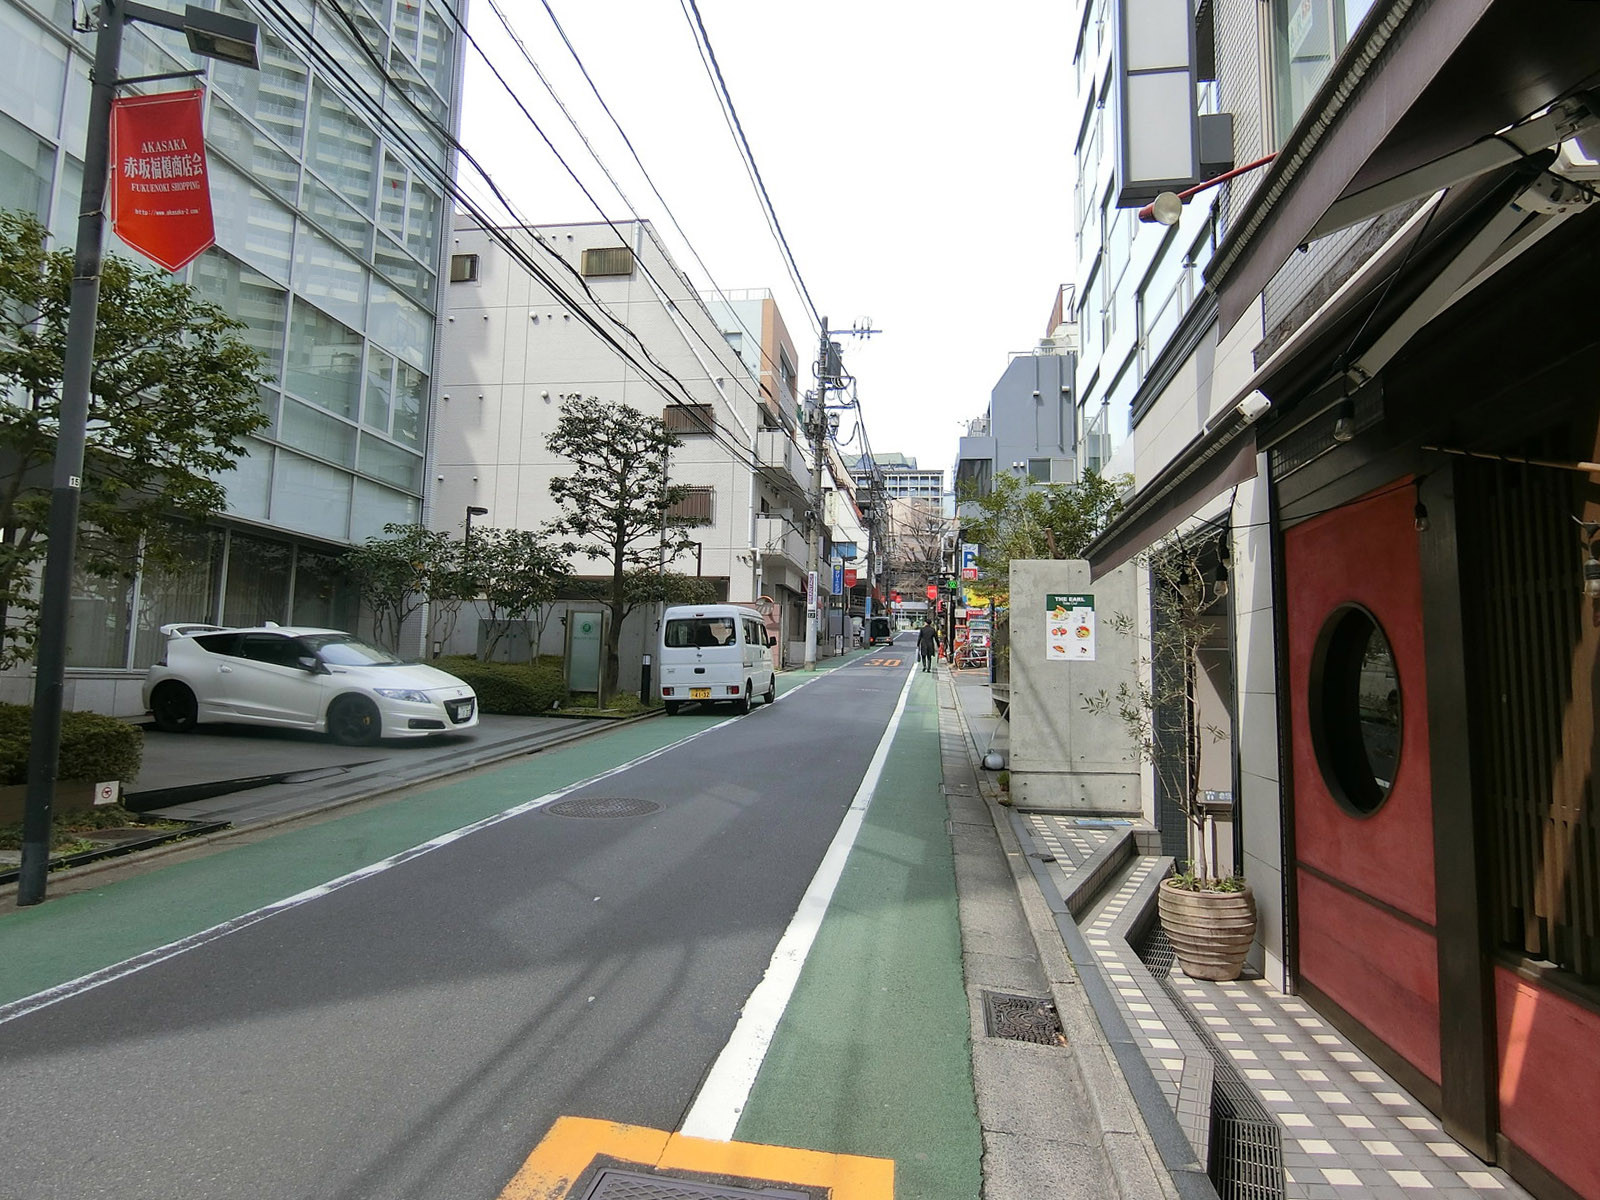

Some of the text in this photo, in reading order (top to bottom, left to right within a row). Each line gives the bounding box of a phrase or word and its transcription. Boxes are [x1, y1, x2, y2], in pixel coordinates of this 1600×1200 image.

[141, 138, 187, 153] AKASAKA
[131, 180, 201, 193] FUKUENOKI SHOPPING
[963, 551, 976, 568] P
[864, 658, 901, 666] 30
